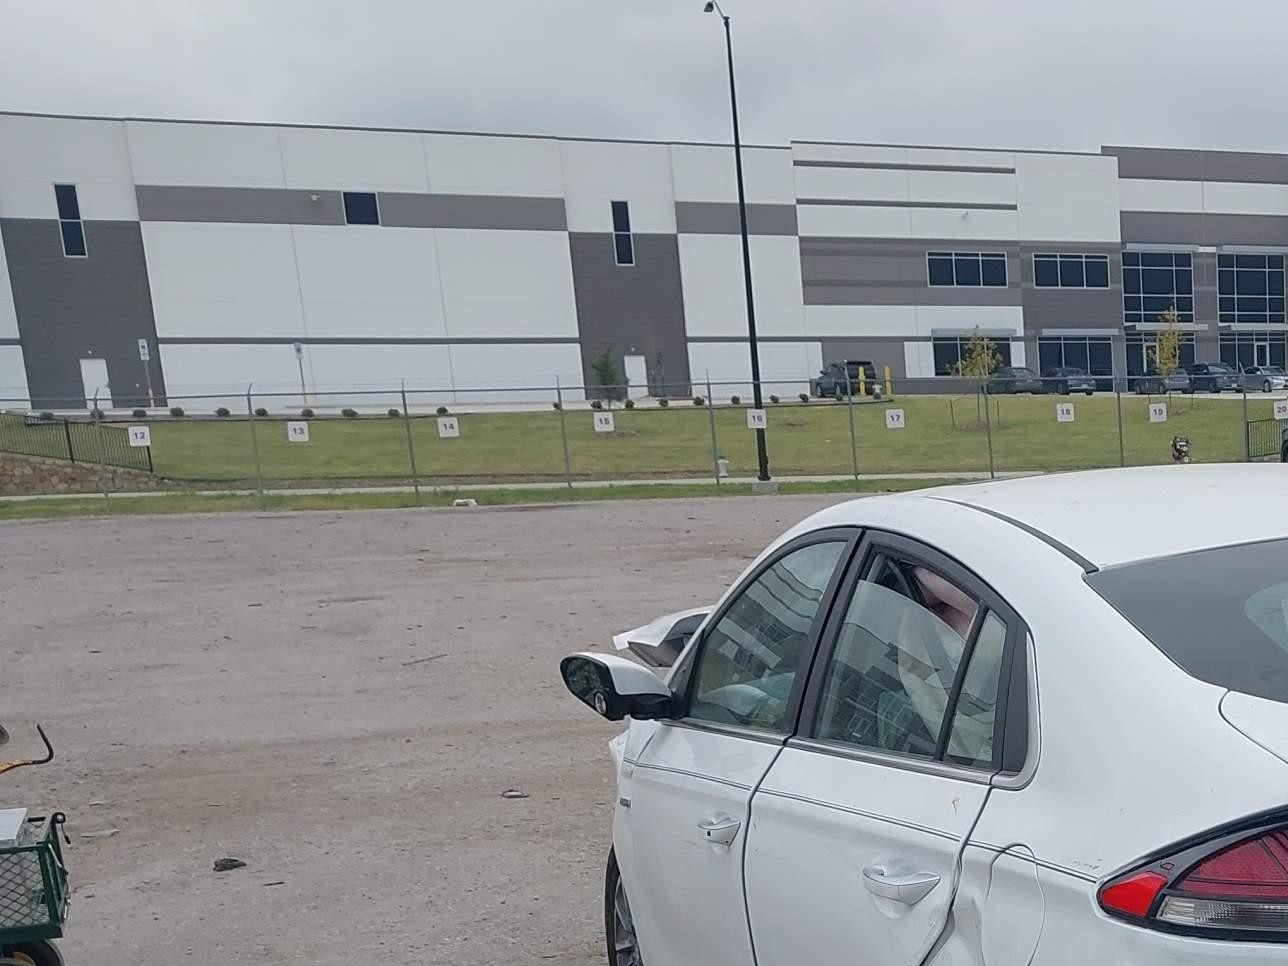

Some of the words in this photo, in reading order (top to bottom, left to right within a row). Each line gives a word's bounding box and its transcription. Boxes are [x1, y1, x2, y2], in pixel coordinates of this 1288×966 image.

[1060, 408, 1071, 416] 18
[1153, 408, 1164, 416] 19
[1277, 405, 1288, 413] 20
[599, 416, 610, 425] 15
[752, 415, 763, 423] 16
[890, 414, 901, 422] 17
[292, 427, 304, 435] 13
[443, 423, 455, 431] 14
[134, 432, 145, 440] 12
